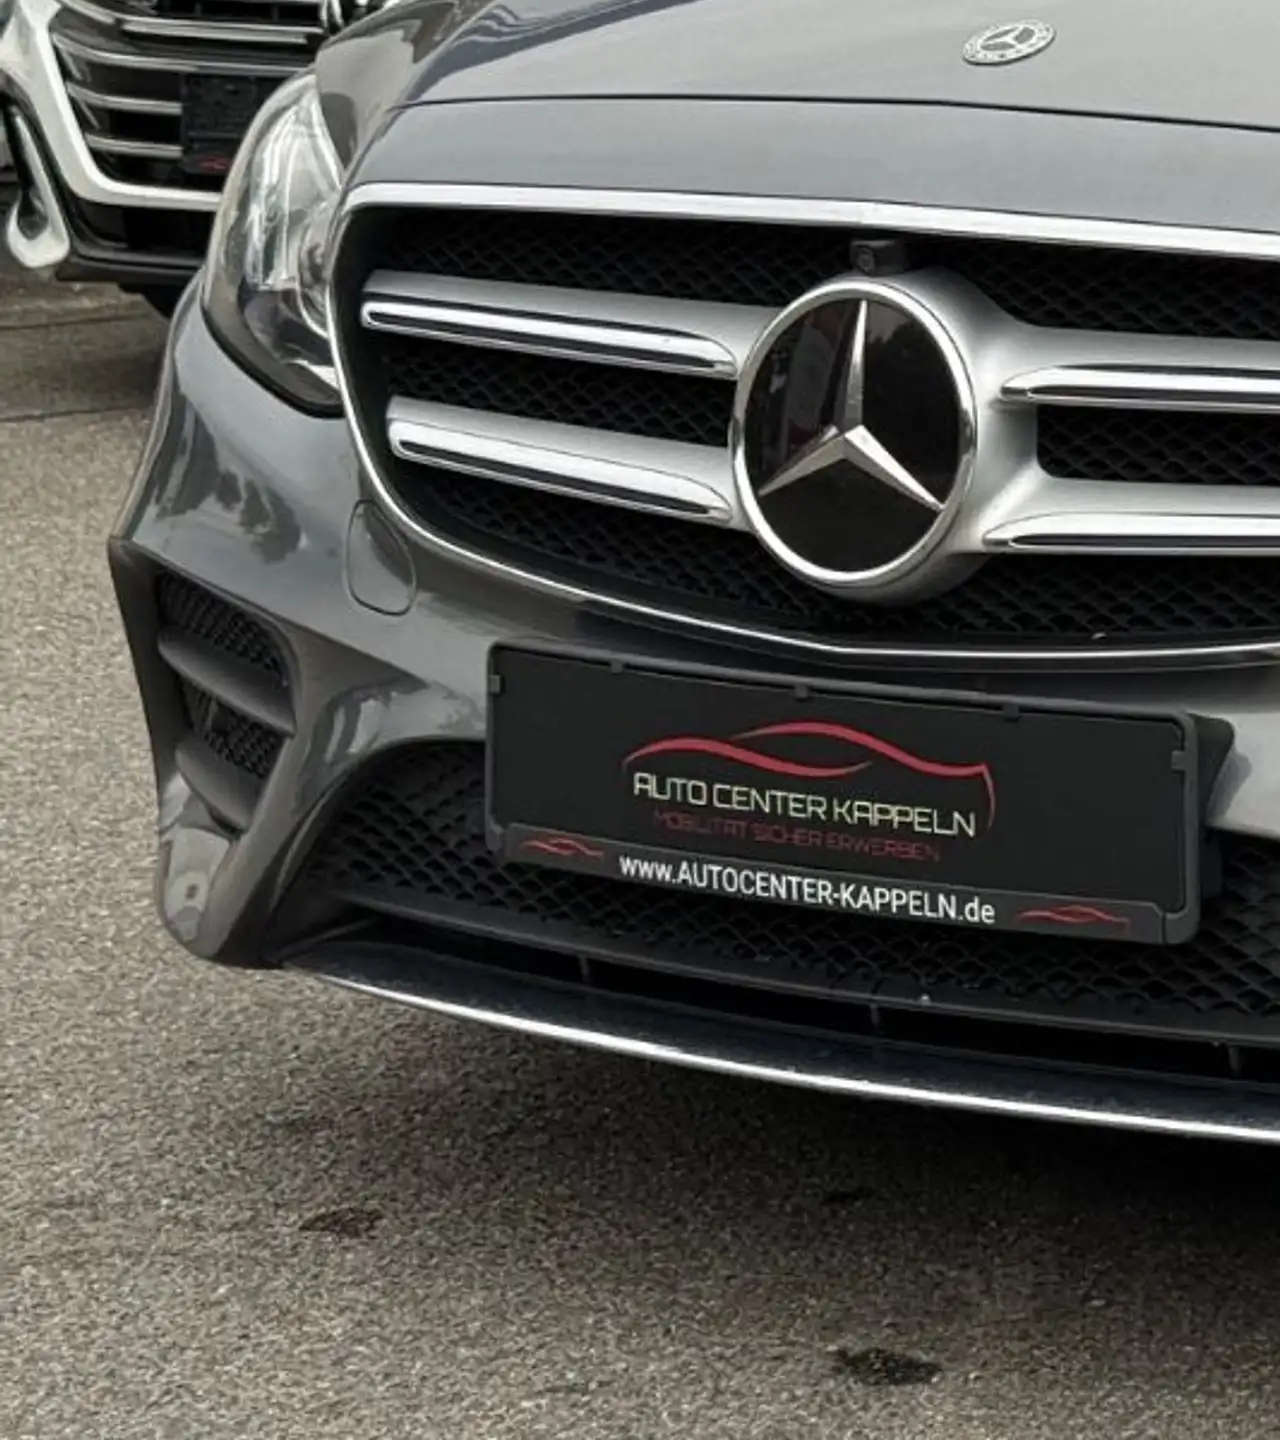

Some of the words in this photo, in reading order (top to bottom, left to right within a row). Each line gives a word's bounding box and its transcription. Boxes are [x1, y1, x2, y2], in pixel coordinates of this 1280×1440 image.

[633, 771, 708, 806] AUTO
[712, 783, 827, 821] CENTER
[832, 797, 976, 838] KAPPELN
[619, 856, 996, 924] www.AUTOCENTER-KAPPELN.de
